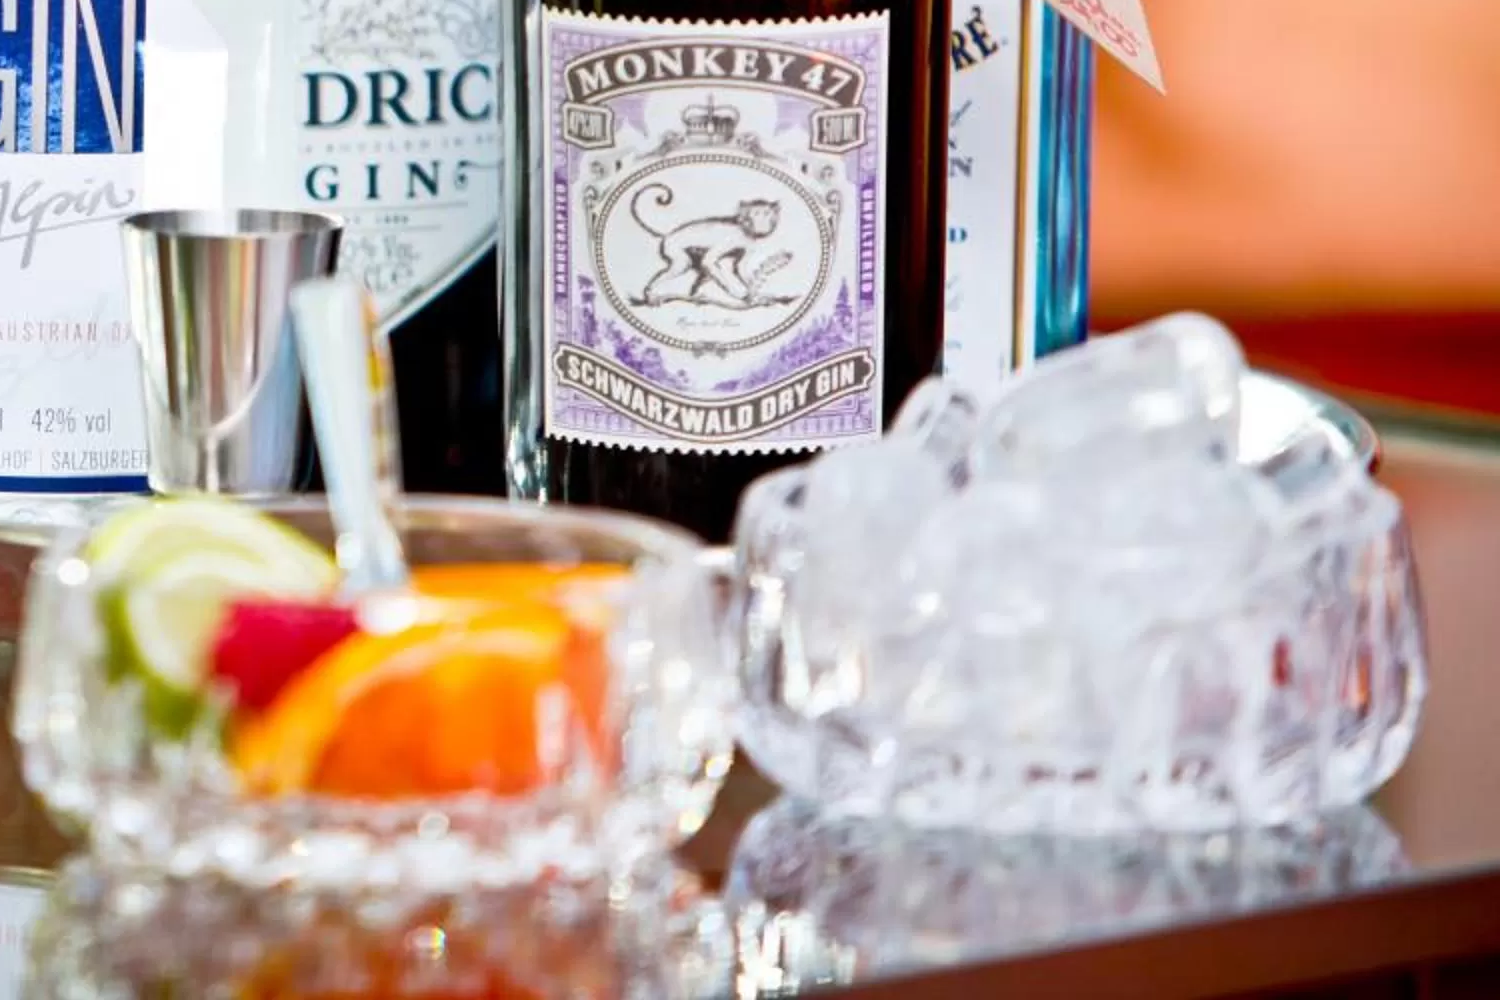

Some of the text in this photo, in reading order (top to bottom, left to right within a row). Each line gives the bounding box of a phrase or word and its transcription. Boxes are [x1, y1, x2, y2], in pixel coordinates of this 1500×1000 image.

[303, 62, 504, 127] DRIC
[575, 46, 853, 97] MONKEY 47
[305, 160, 441, 201] GIN
[30, 406, 78, 434] 42%
[84, 406, 111, 436] vol
[566, 355, 856, 436] SCHWARZWALD DRY GIN
